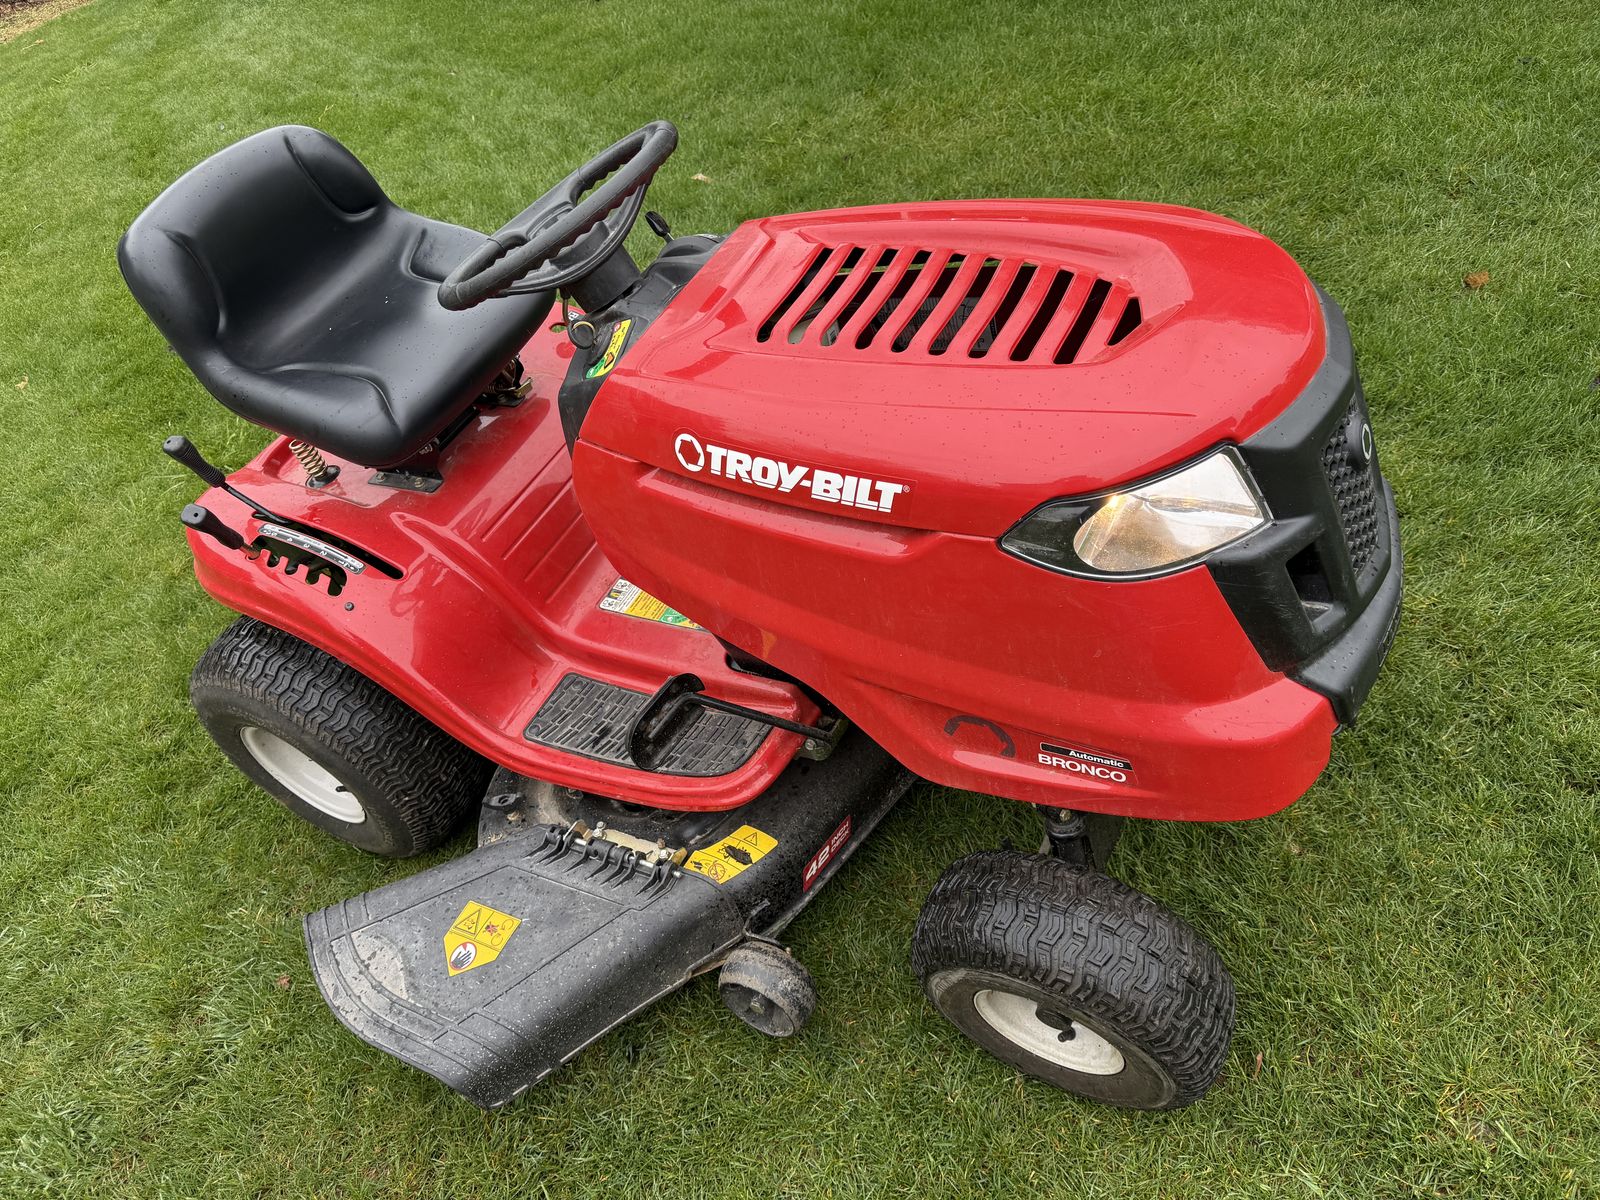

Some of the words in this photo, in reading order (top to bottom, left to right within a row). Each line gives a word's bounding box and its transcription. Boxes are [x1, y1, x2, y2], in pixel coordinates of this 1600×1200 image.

[1038, 753, 1127, 782] BRONCO
[1069, 750, 1124, 768] Automatic
[831, 821, 849, 845] INCH
[806, 845, 830, 881] 42
